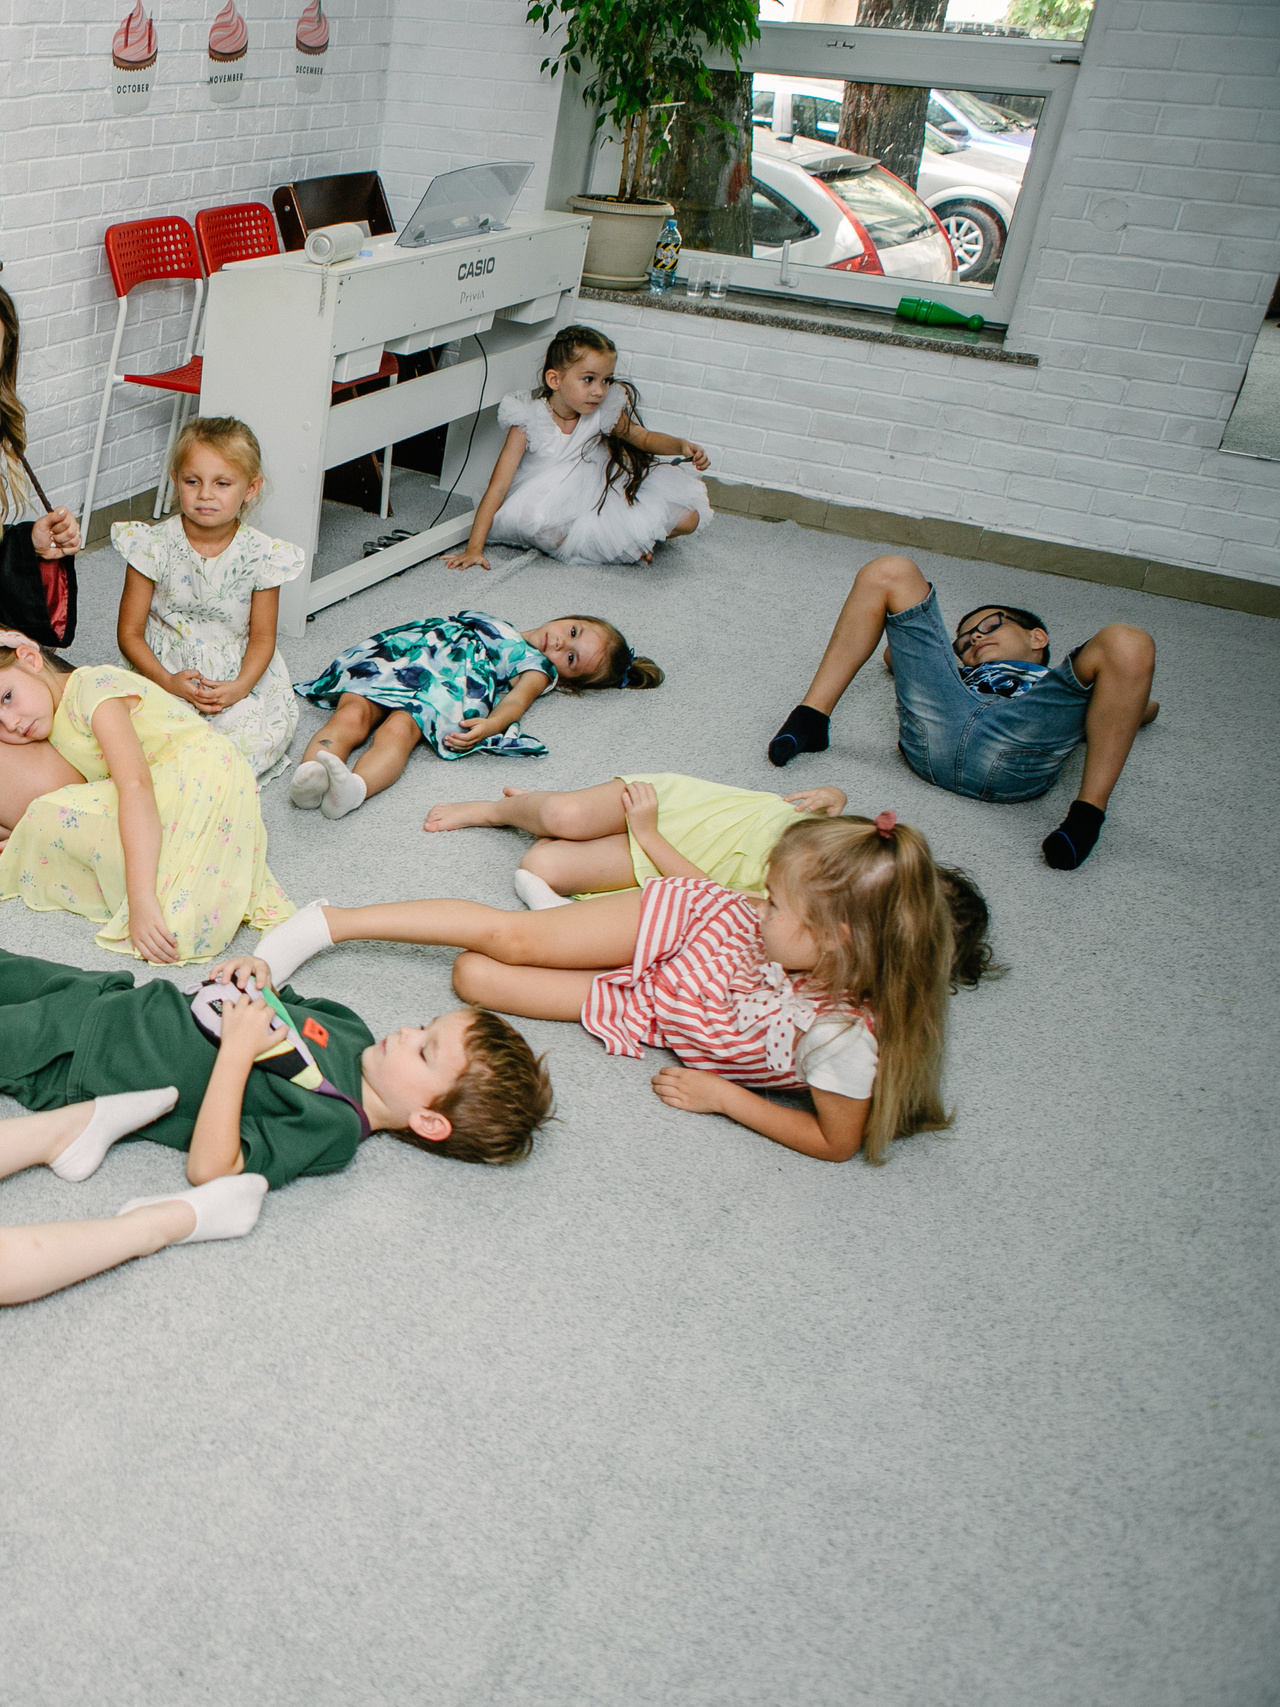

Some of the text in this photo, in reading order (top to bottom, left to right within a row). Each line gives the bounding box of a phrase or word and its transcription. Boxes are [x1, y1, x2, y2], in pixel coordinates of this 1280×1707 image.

[295, 65, 324, 75] DECEMBER
[209, 73, 244, 84] NOVEMBER
[116, 83, 150, 94] OCTOBER
[457, 256, 496, 281] CASIO
